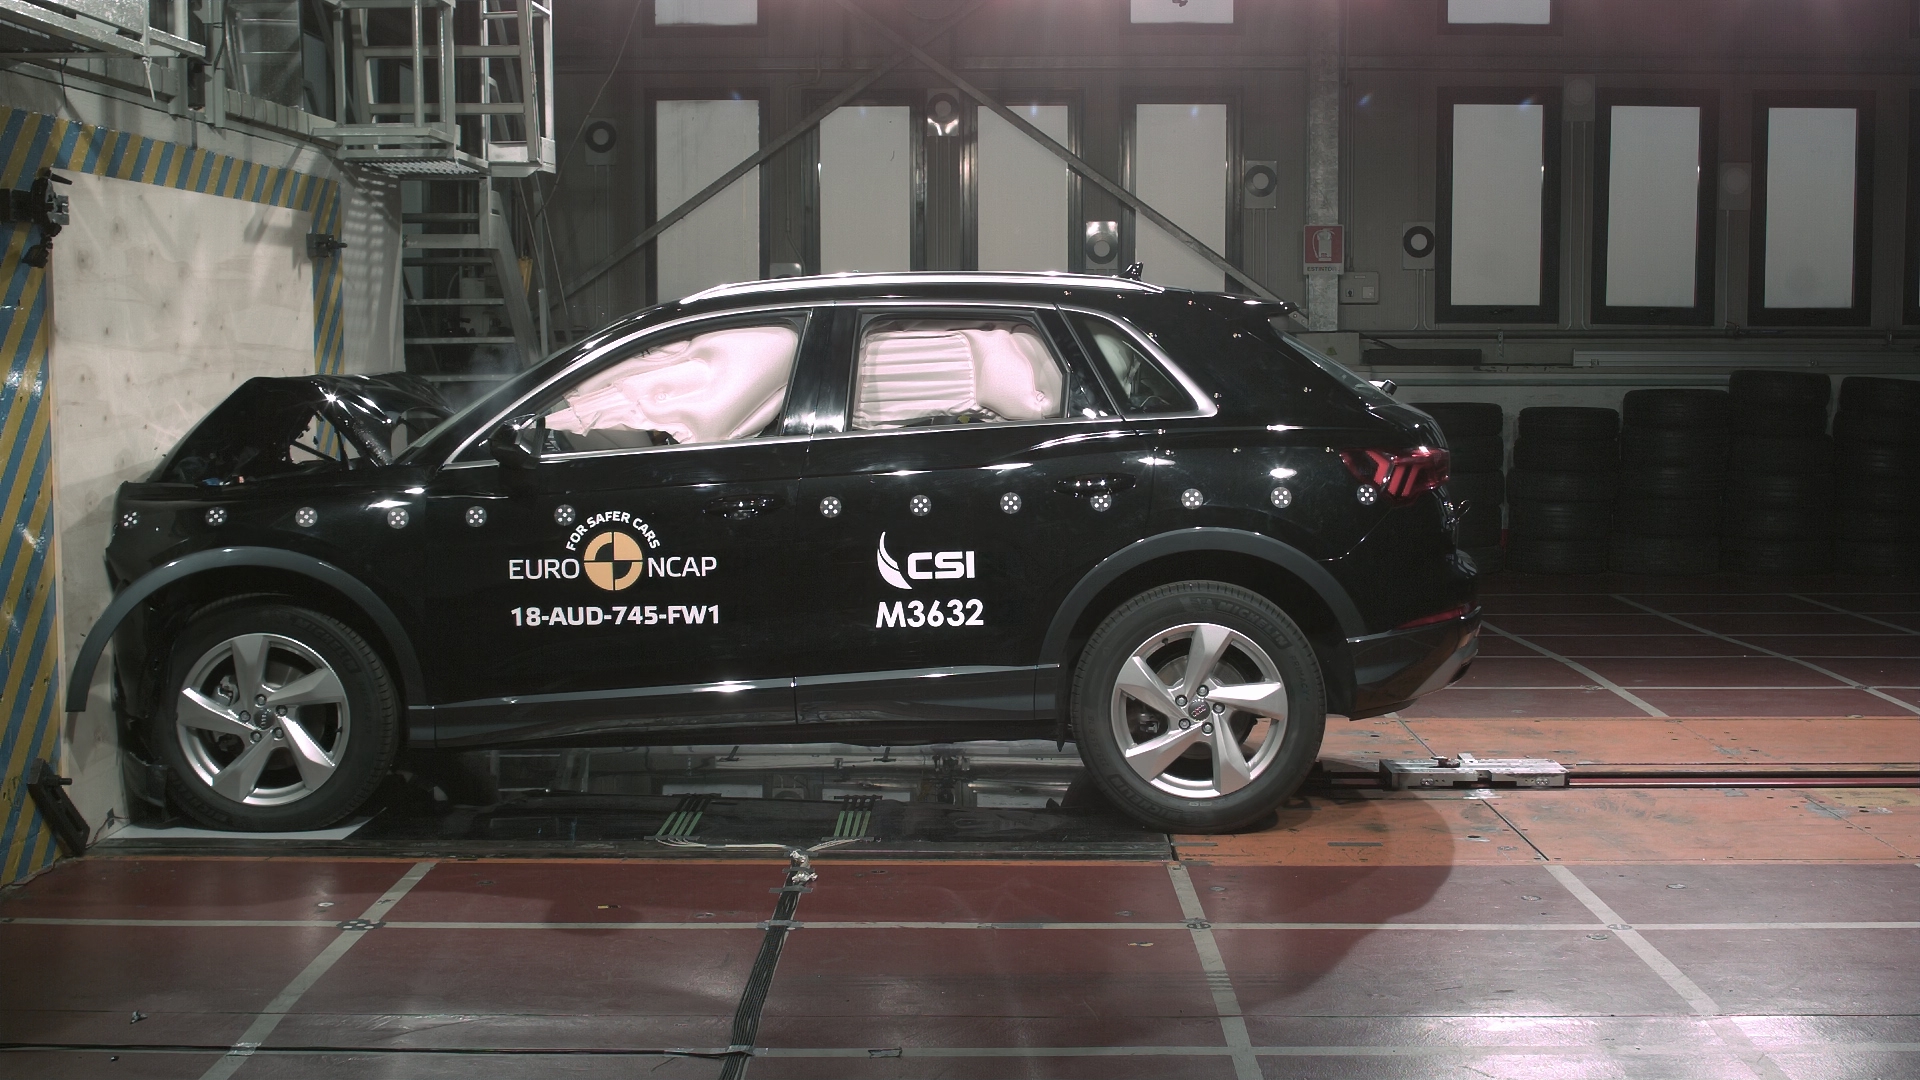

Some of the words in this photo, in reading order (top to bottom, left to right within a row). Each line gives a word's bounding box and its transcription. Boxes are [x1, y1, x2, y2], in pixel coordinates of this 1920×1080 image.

[566, 524, 588, 552] FOR
[586, 510, 631, 529] SAFER
[632, 517, 661, 549] CARS
[508, 558, 580, 580] EURO
[647, 556, 718, 578] NCAP
[907, 550, 976, 580] CSI
[510, 604, 720, 627] 18-AUD-745-FW1
[875, 598, 985, 629] M3632
[1218, 600, 1291, 649] MICHELIN
[1108, 774, 1186, 819] MICHELIN
